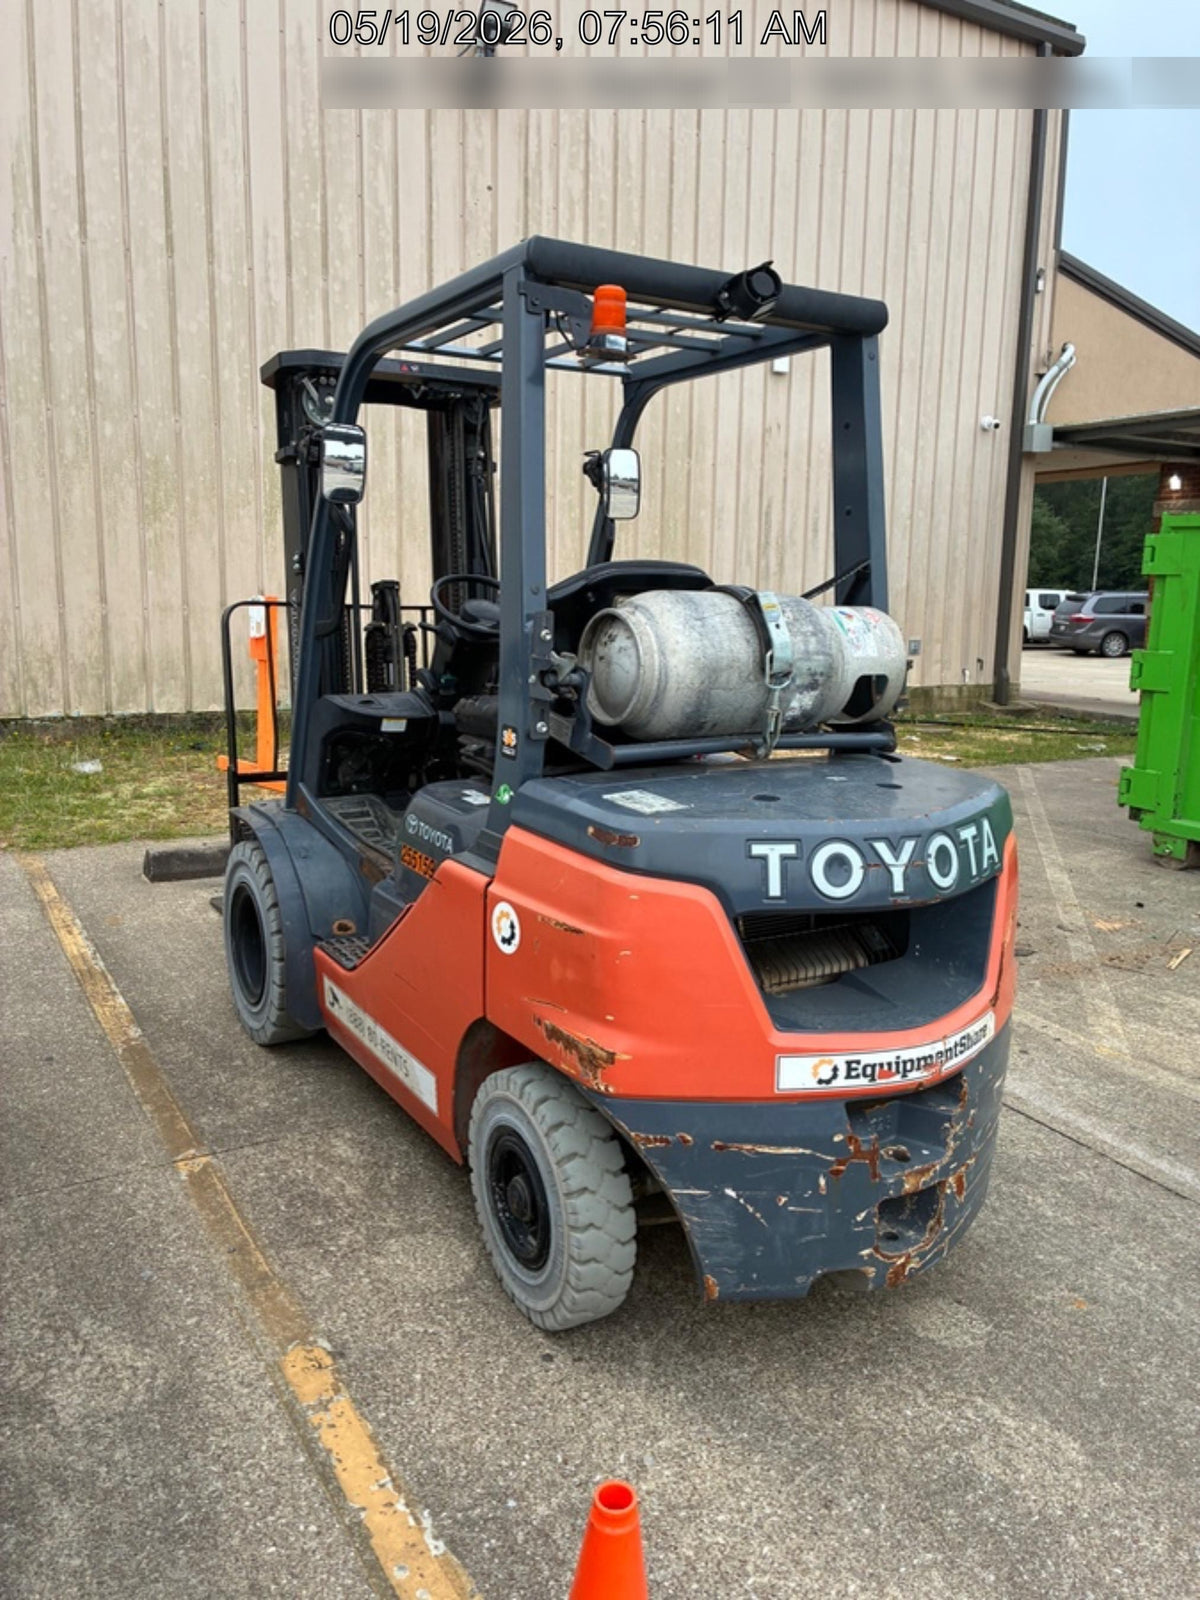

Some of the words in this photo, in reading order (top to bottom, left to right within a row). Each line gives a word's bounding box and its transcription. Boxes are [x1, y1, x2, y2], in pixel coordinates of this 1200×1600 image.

[418, 821, 454, 853] TOYOTA
[748, 816, 1000, 900] TOYOTA
[844, 1023, 989, 1082] EquipmentShare
